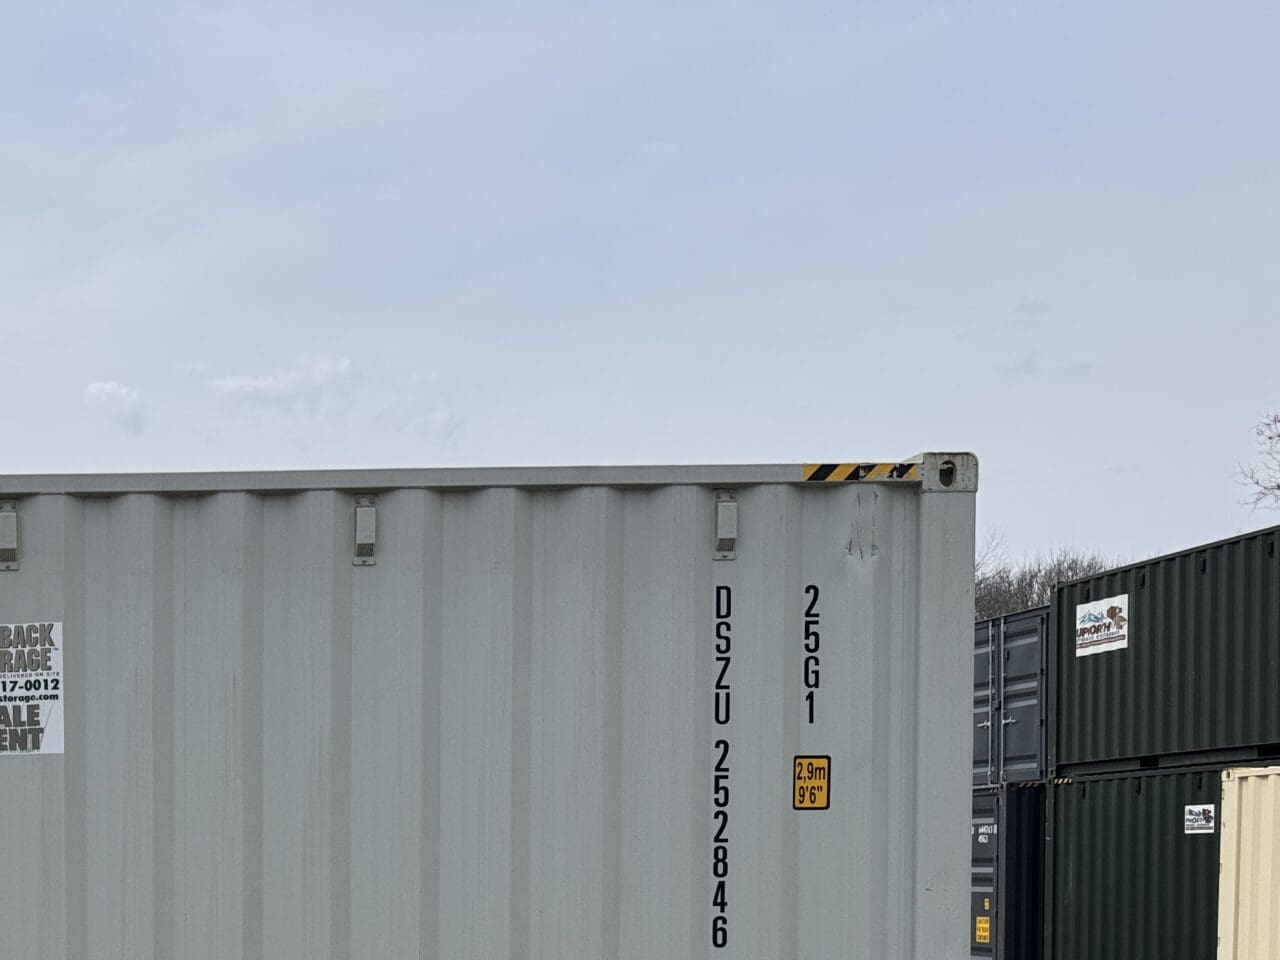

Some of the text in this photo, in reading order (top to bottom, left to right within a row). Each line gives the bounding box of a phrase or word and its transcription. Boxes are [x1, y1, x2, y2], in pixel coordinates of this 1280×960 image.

[714, 585, 732, 725] DSZU
[803, 584, 820, 724] 25G1
[797, 761, 826, 784] 2,9m
[712, 739, 730, 948] 252846
